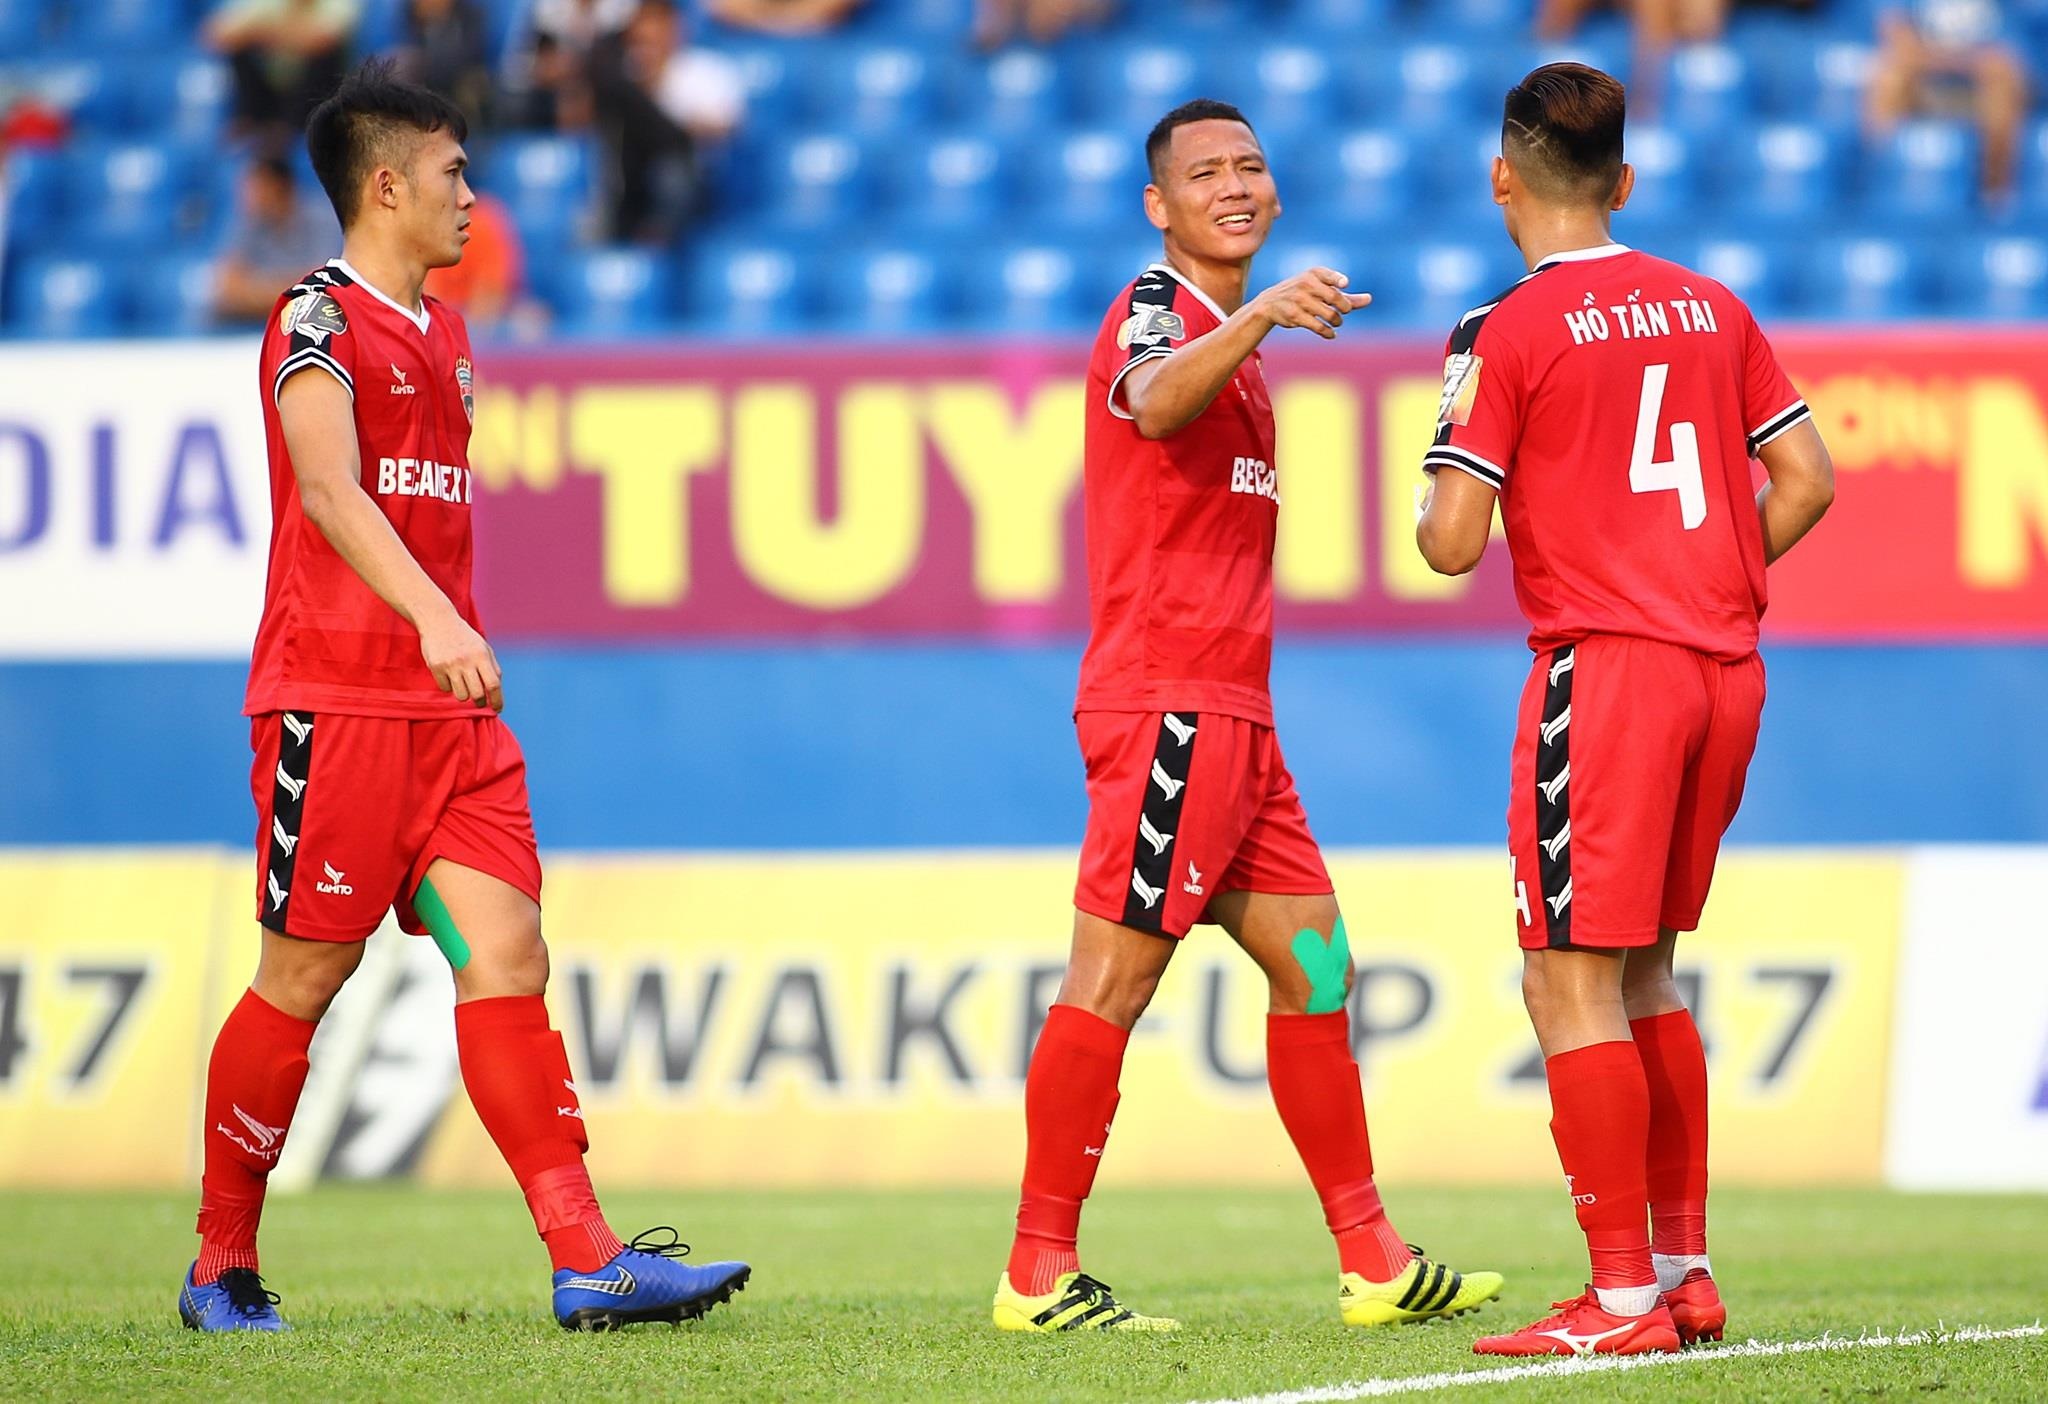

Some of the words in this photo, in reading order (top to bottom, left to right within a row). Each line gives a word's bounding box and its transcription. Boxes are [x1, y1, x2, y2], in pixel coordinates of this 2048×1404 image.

[1563, 291, 1610, 345] HỒ
[1609, 288, 1671, 340] TẤN
[1669, 285, 1719, 333] TÀI
[1629, 363, 1708, 531] 4
[316, 881, 353, 896] KAMITO
